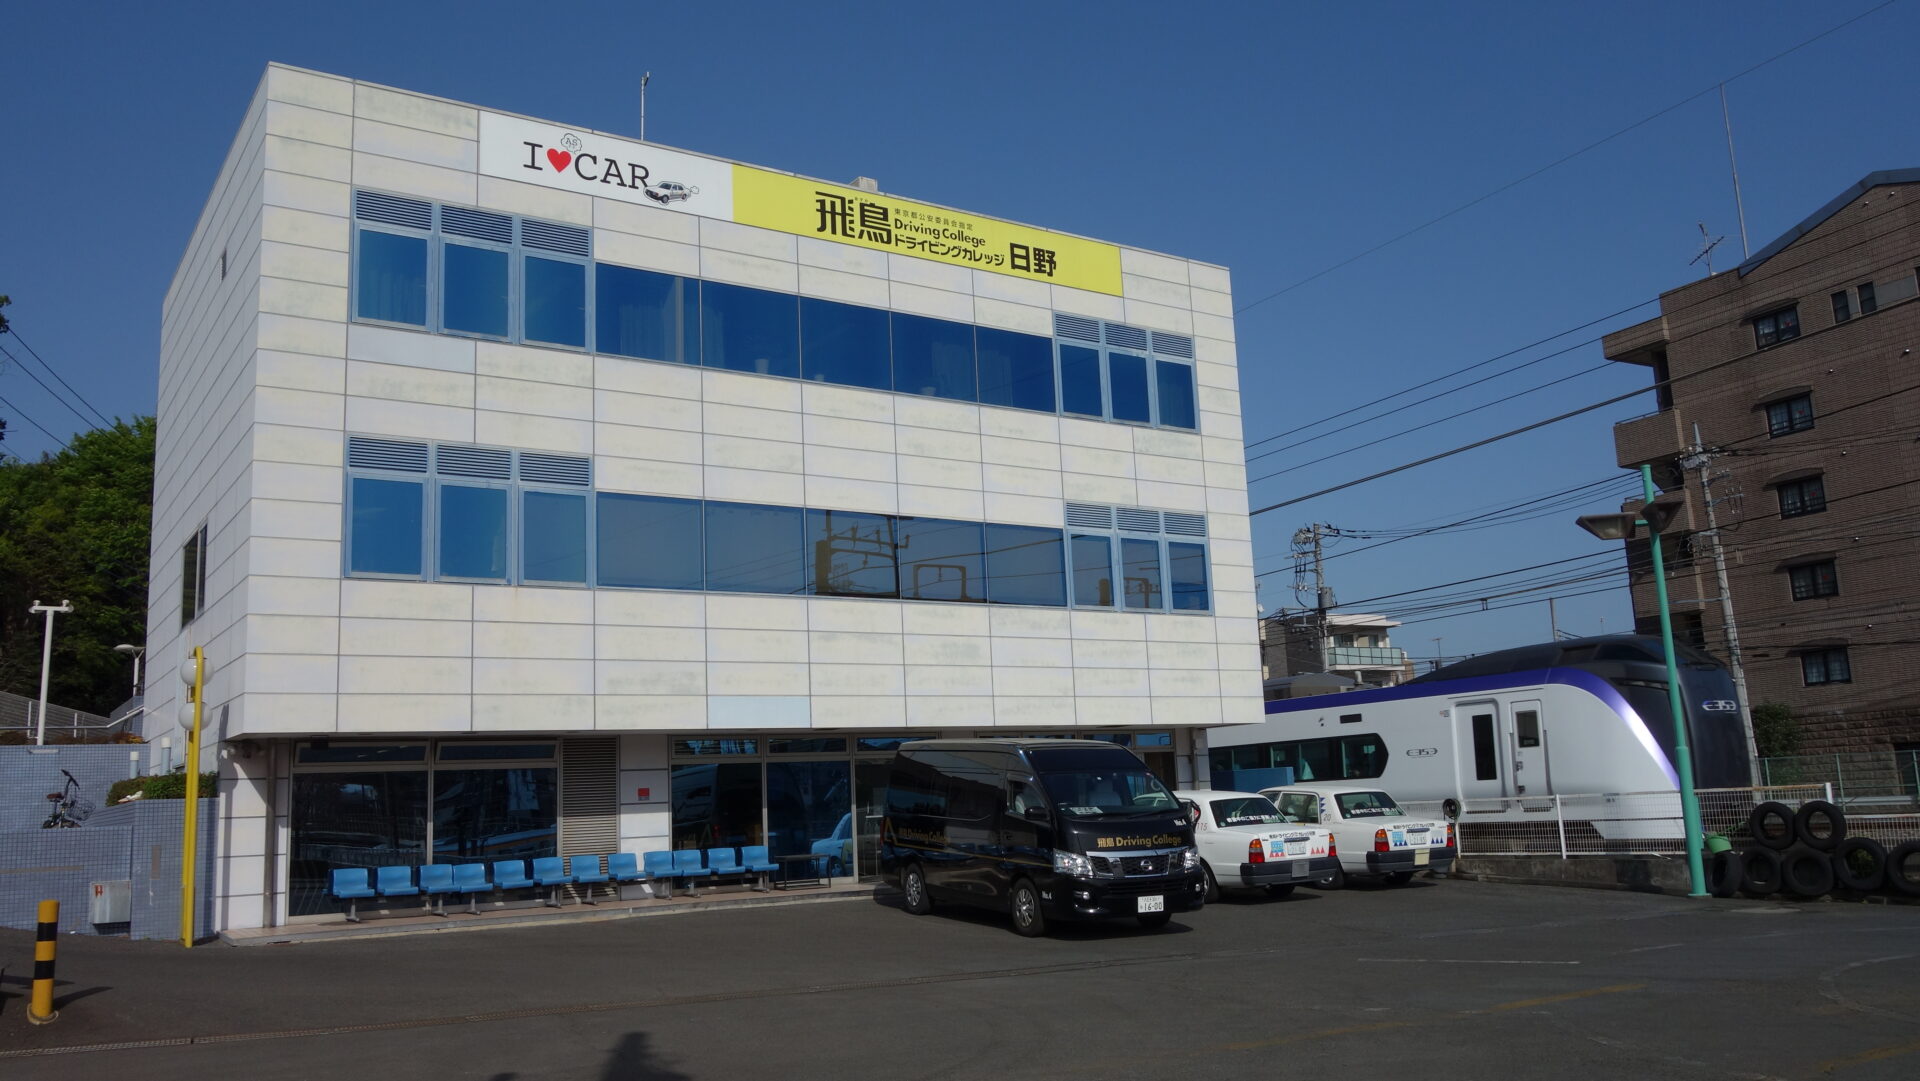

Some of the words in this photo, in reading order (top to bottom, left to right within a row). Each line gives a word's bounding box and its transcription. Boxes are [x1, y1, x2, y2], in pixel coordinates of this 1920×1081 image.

[523, 141, 543, 171] I
[574, 153, 650, 189] CAR
[815, 191, 892, 245] 飛鳥
[894, 208, 974, 231] 東京都公安委員会指定
[895, 218, 941, 239] Driving
[942, 228, 986, 247] College
[895, 234, 1005, 266] ドライビングカレッジ
[1009, 242, 1057, 277] 日野
[1096, 837, 1115, 848] 飛鳥
[1116, 835, 1152, 847] Driving
[1152, 834, 1182, 845] College
